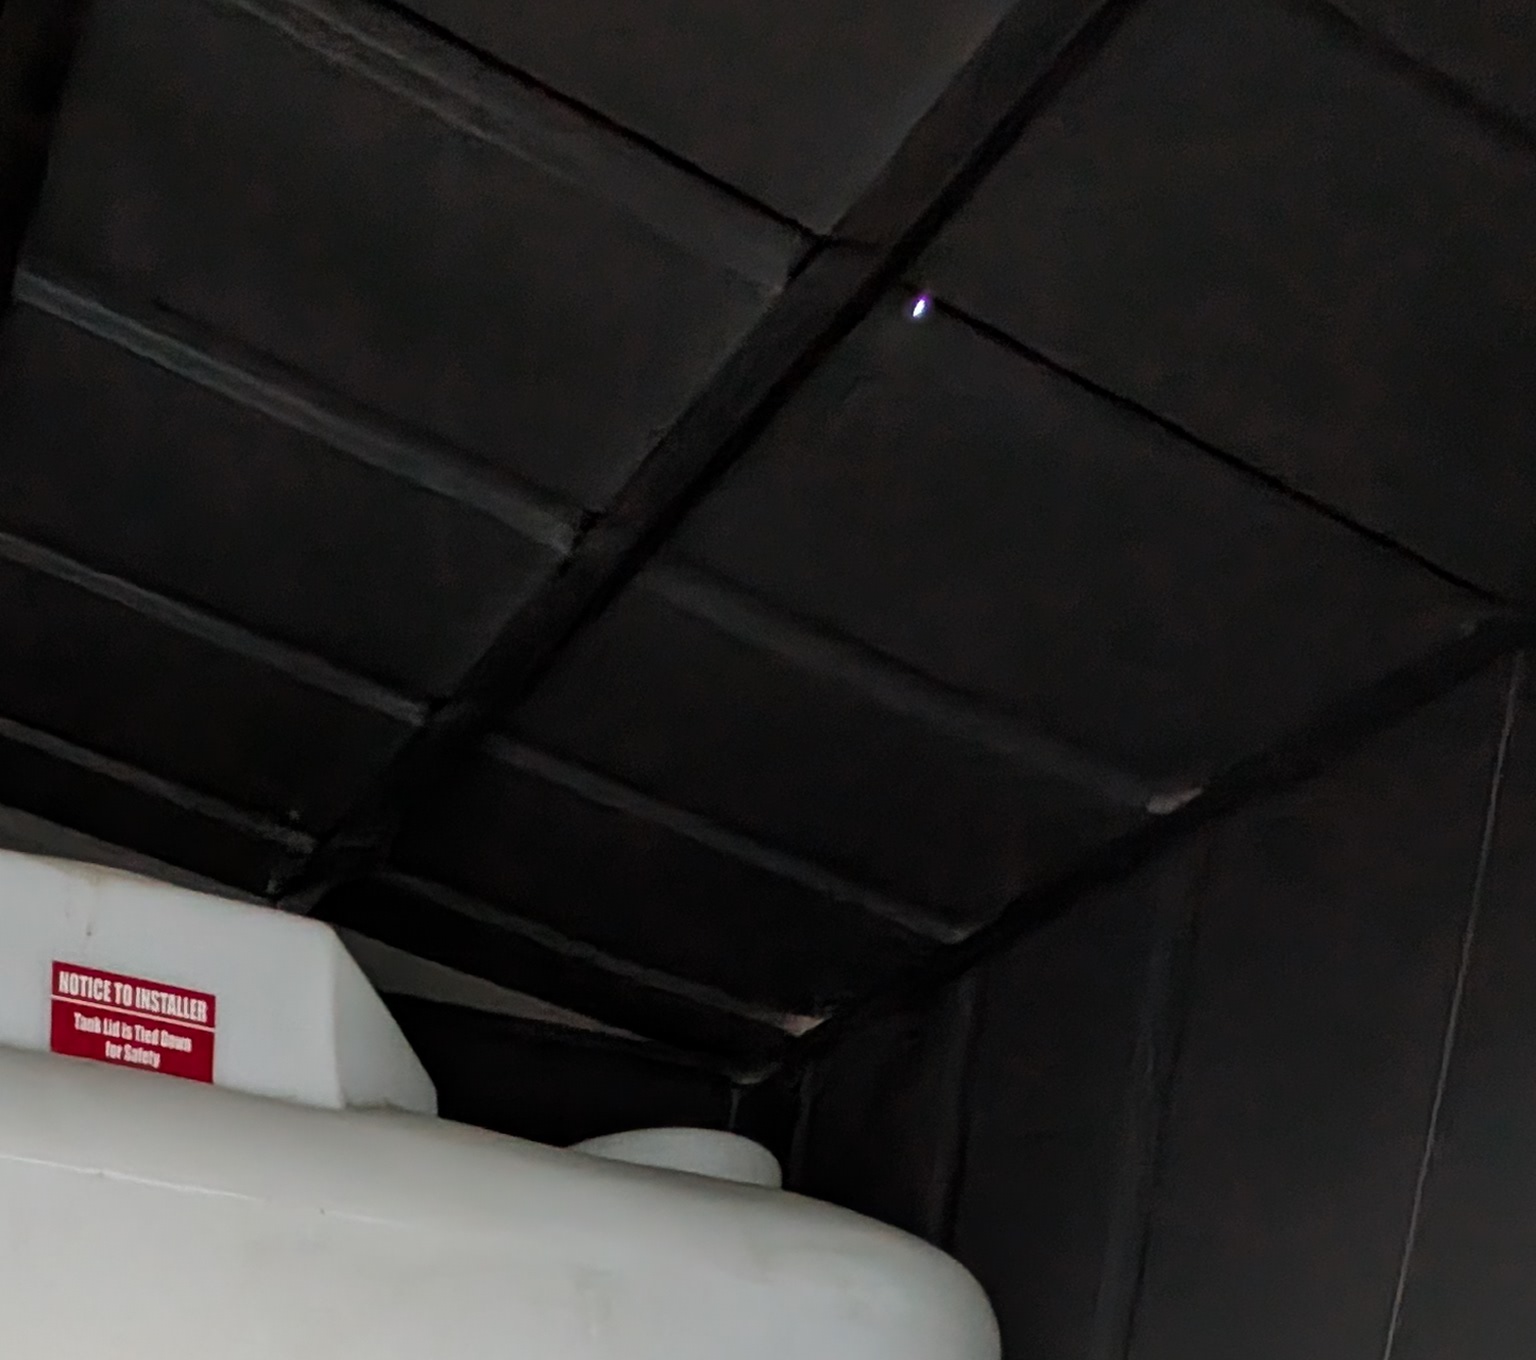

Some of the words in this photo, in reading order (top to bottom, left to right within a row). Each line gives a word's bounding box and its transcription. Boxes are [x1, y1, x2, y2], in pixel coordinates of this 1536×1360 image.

[58, 970, 112, 1003] NOTICE
[113, 982, 133, 1007] TO
[135, 986, 208, 1023] INSTALLER
[73, 1011, 102, 1034] Tank
[103, 1017, 121, 1039] Lid
[134, 1024, 160, 1047] Tied
[160, 1029, 192, 1053] Down
[105, 1040, 122, 1060] for
[123, 1043, 161, 1069] Safety
